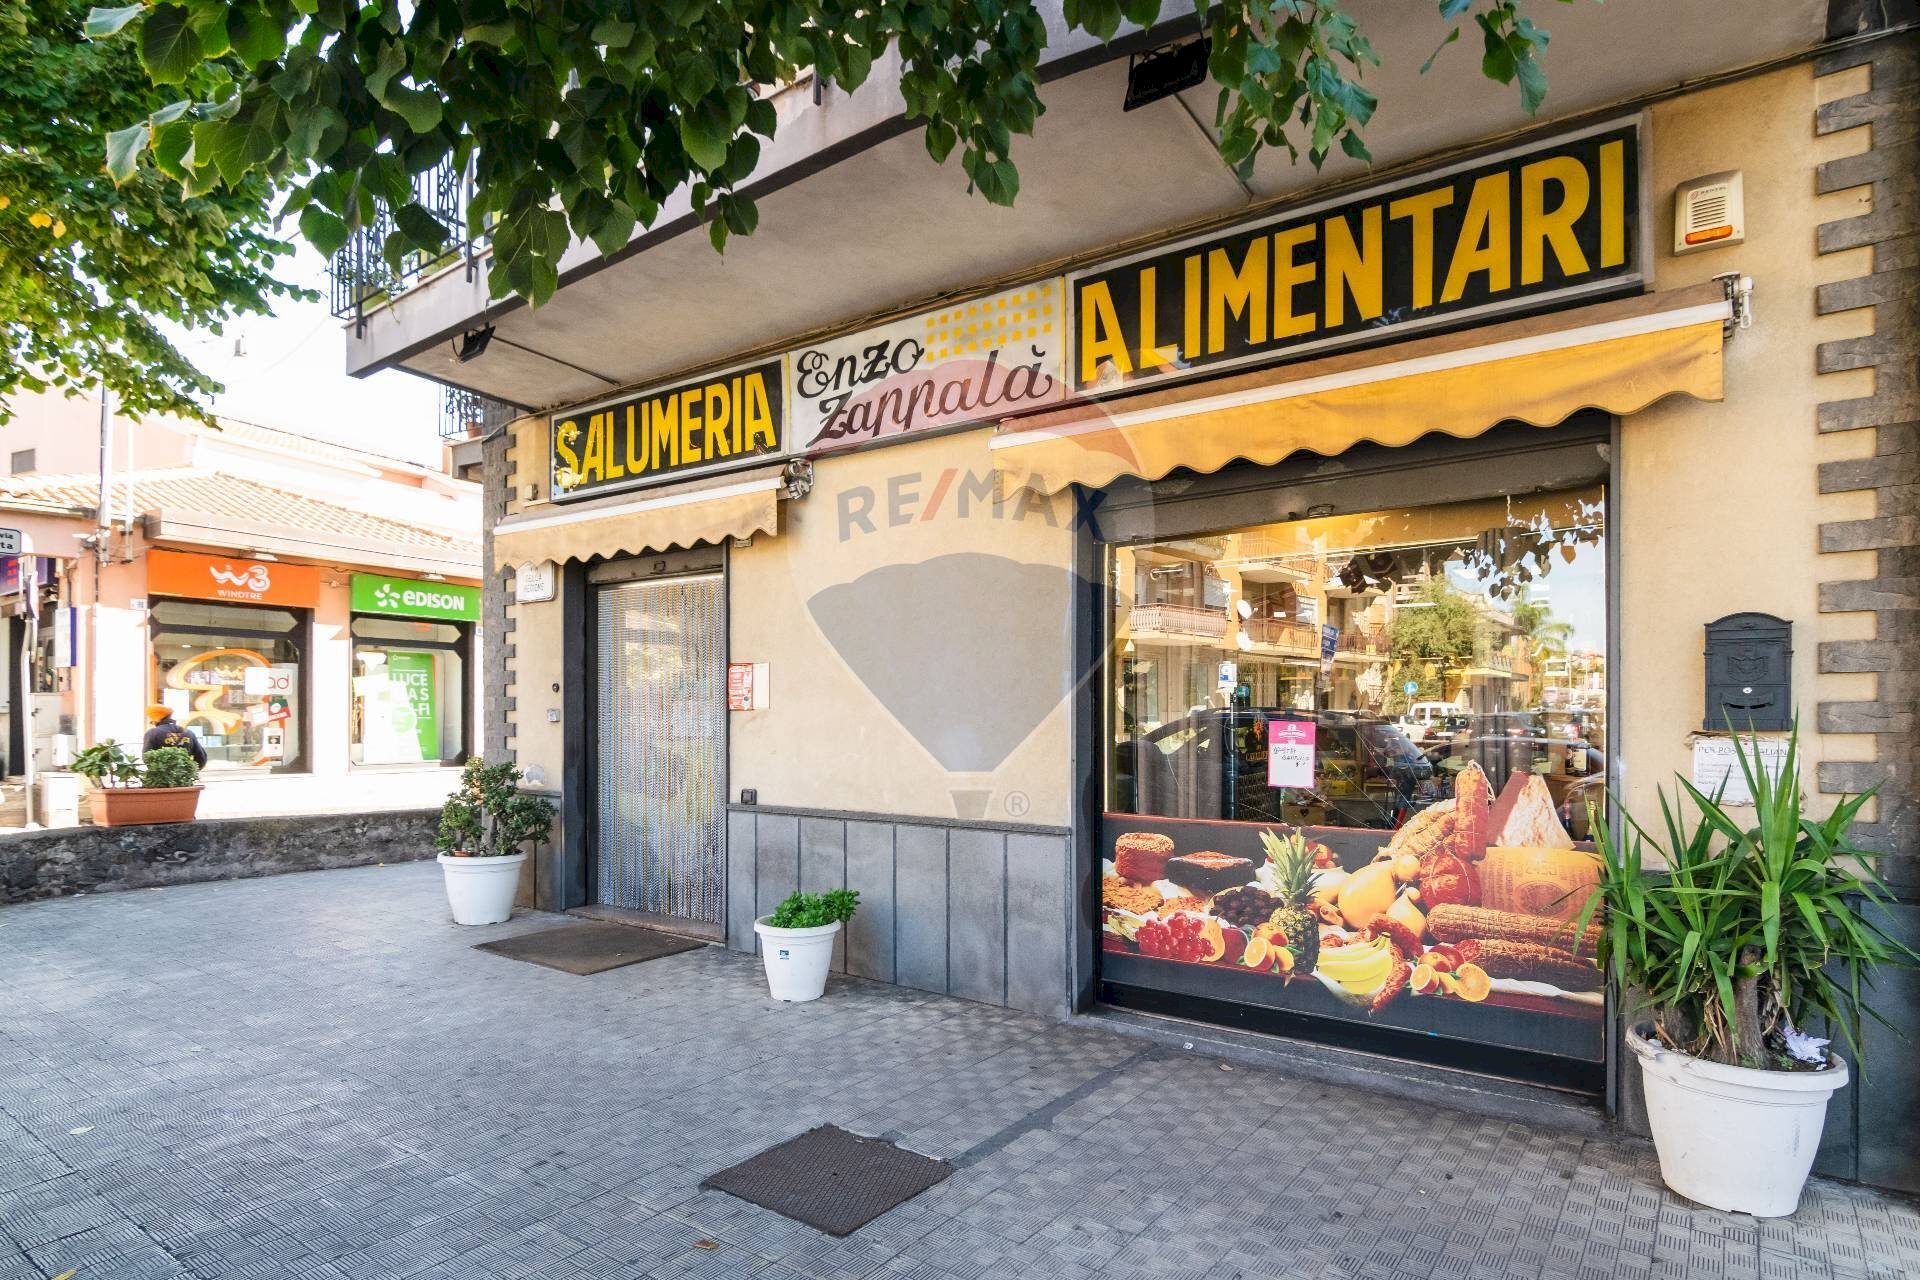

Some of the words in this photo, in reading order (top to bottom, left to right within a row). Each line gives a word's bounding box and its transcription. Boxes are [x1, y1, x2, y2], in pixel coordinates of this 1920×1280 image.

[1080, 139, 1625, 383] ALIMENTARI
[796, 335, 926, 399] Enzo
[806, 345, 1054, 449] Zappalà
[553, 371, 776, 490] SALUMERIA
[216, 589, 263, 600] WINDTRE
